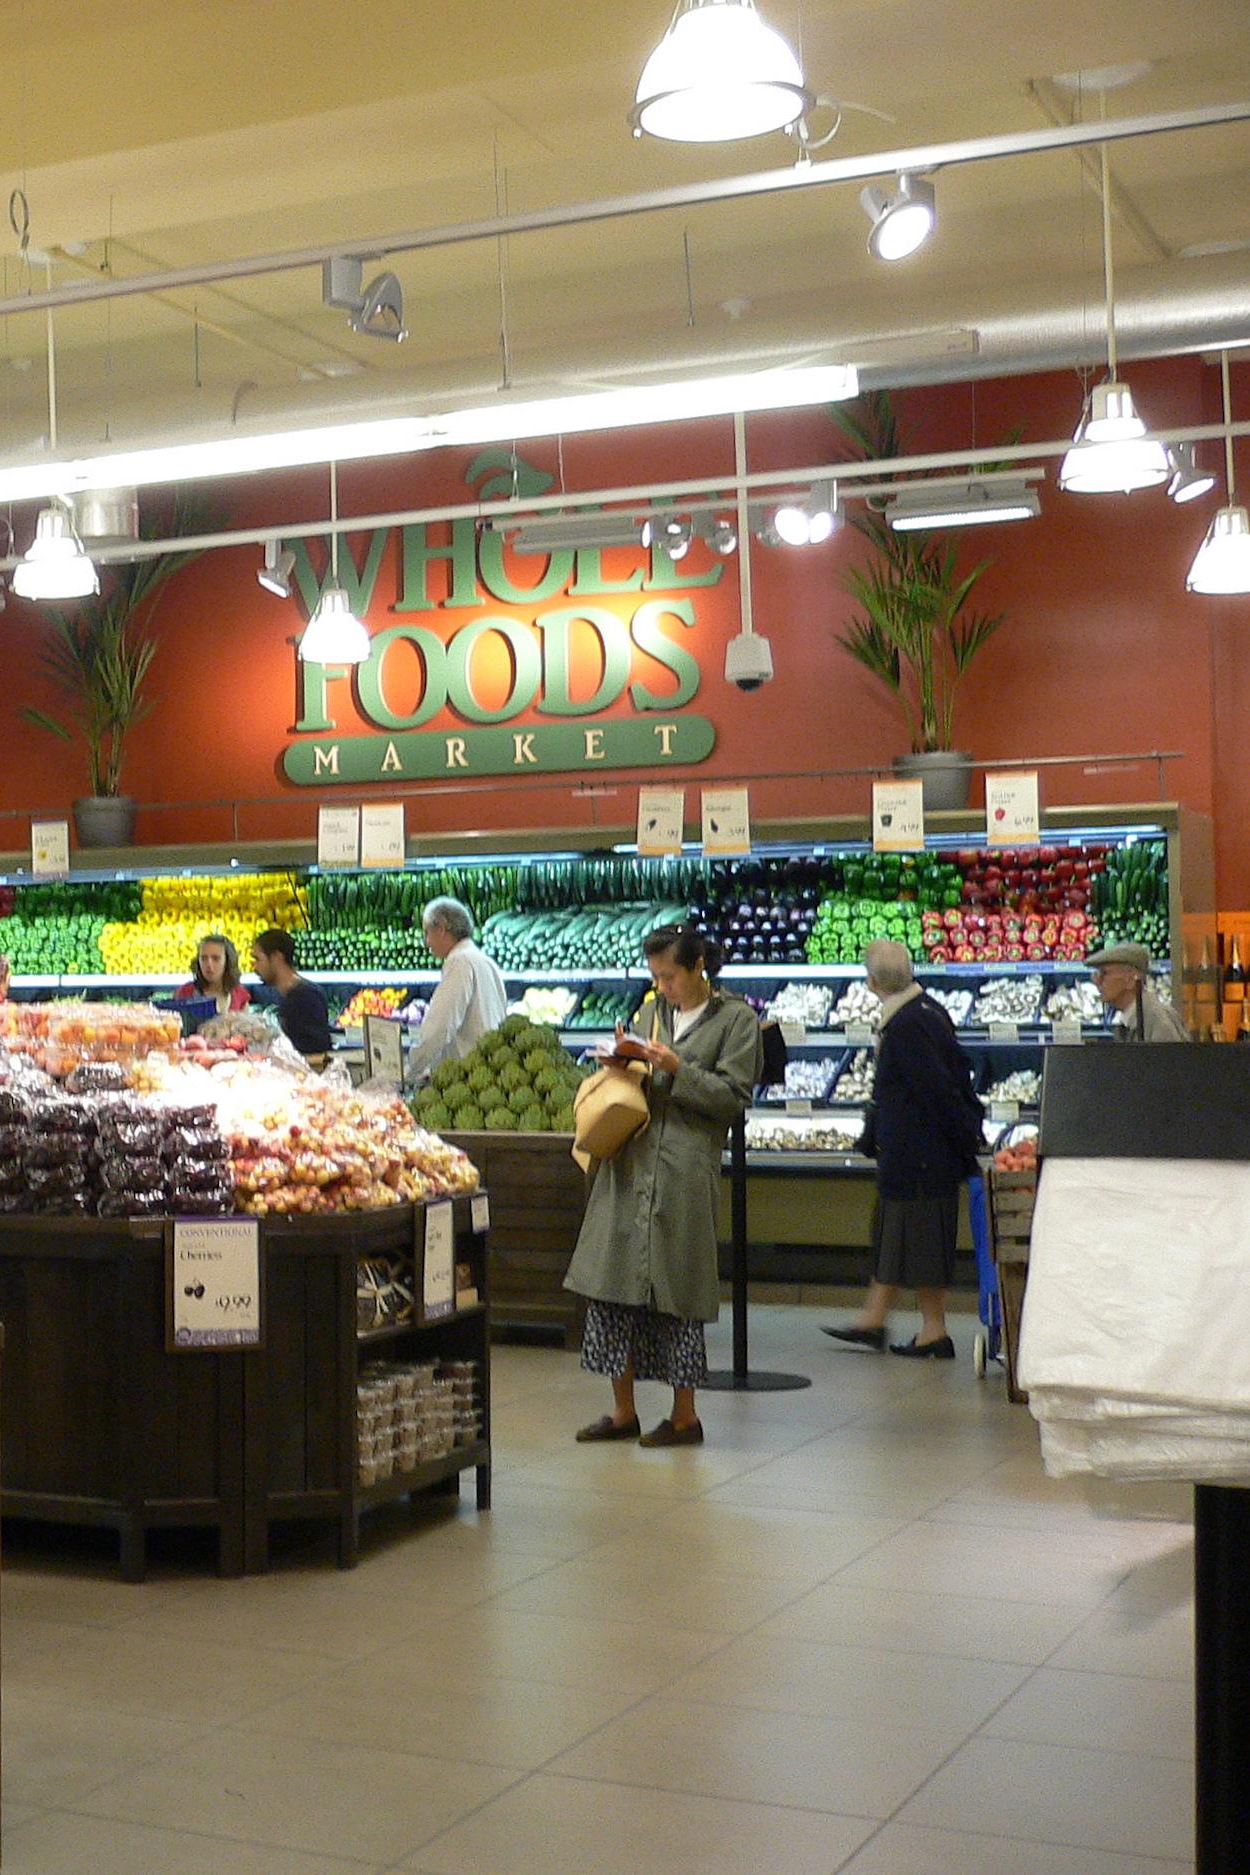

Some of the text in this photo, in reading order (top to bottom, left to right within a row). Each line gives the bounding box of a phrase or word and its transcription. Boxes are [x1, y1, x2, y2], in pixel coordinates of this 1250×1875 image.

[284, 490, 725, 617] WHOLE
[290, 599, 701, 732] FOODS
[314, 724, 678, 776] MARKET
